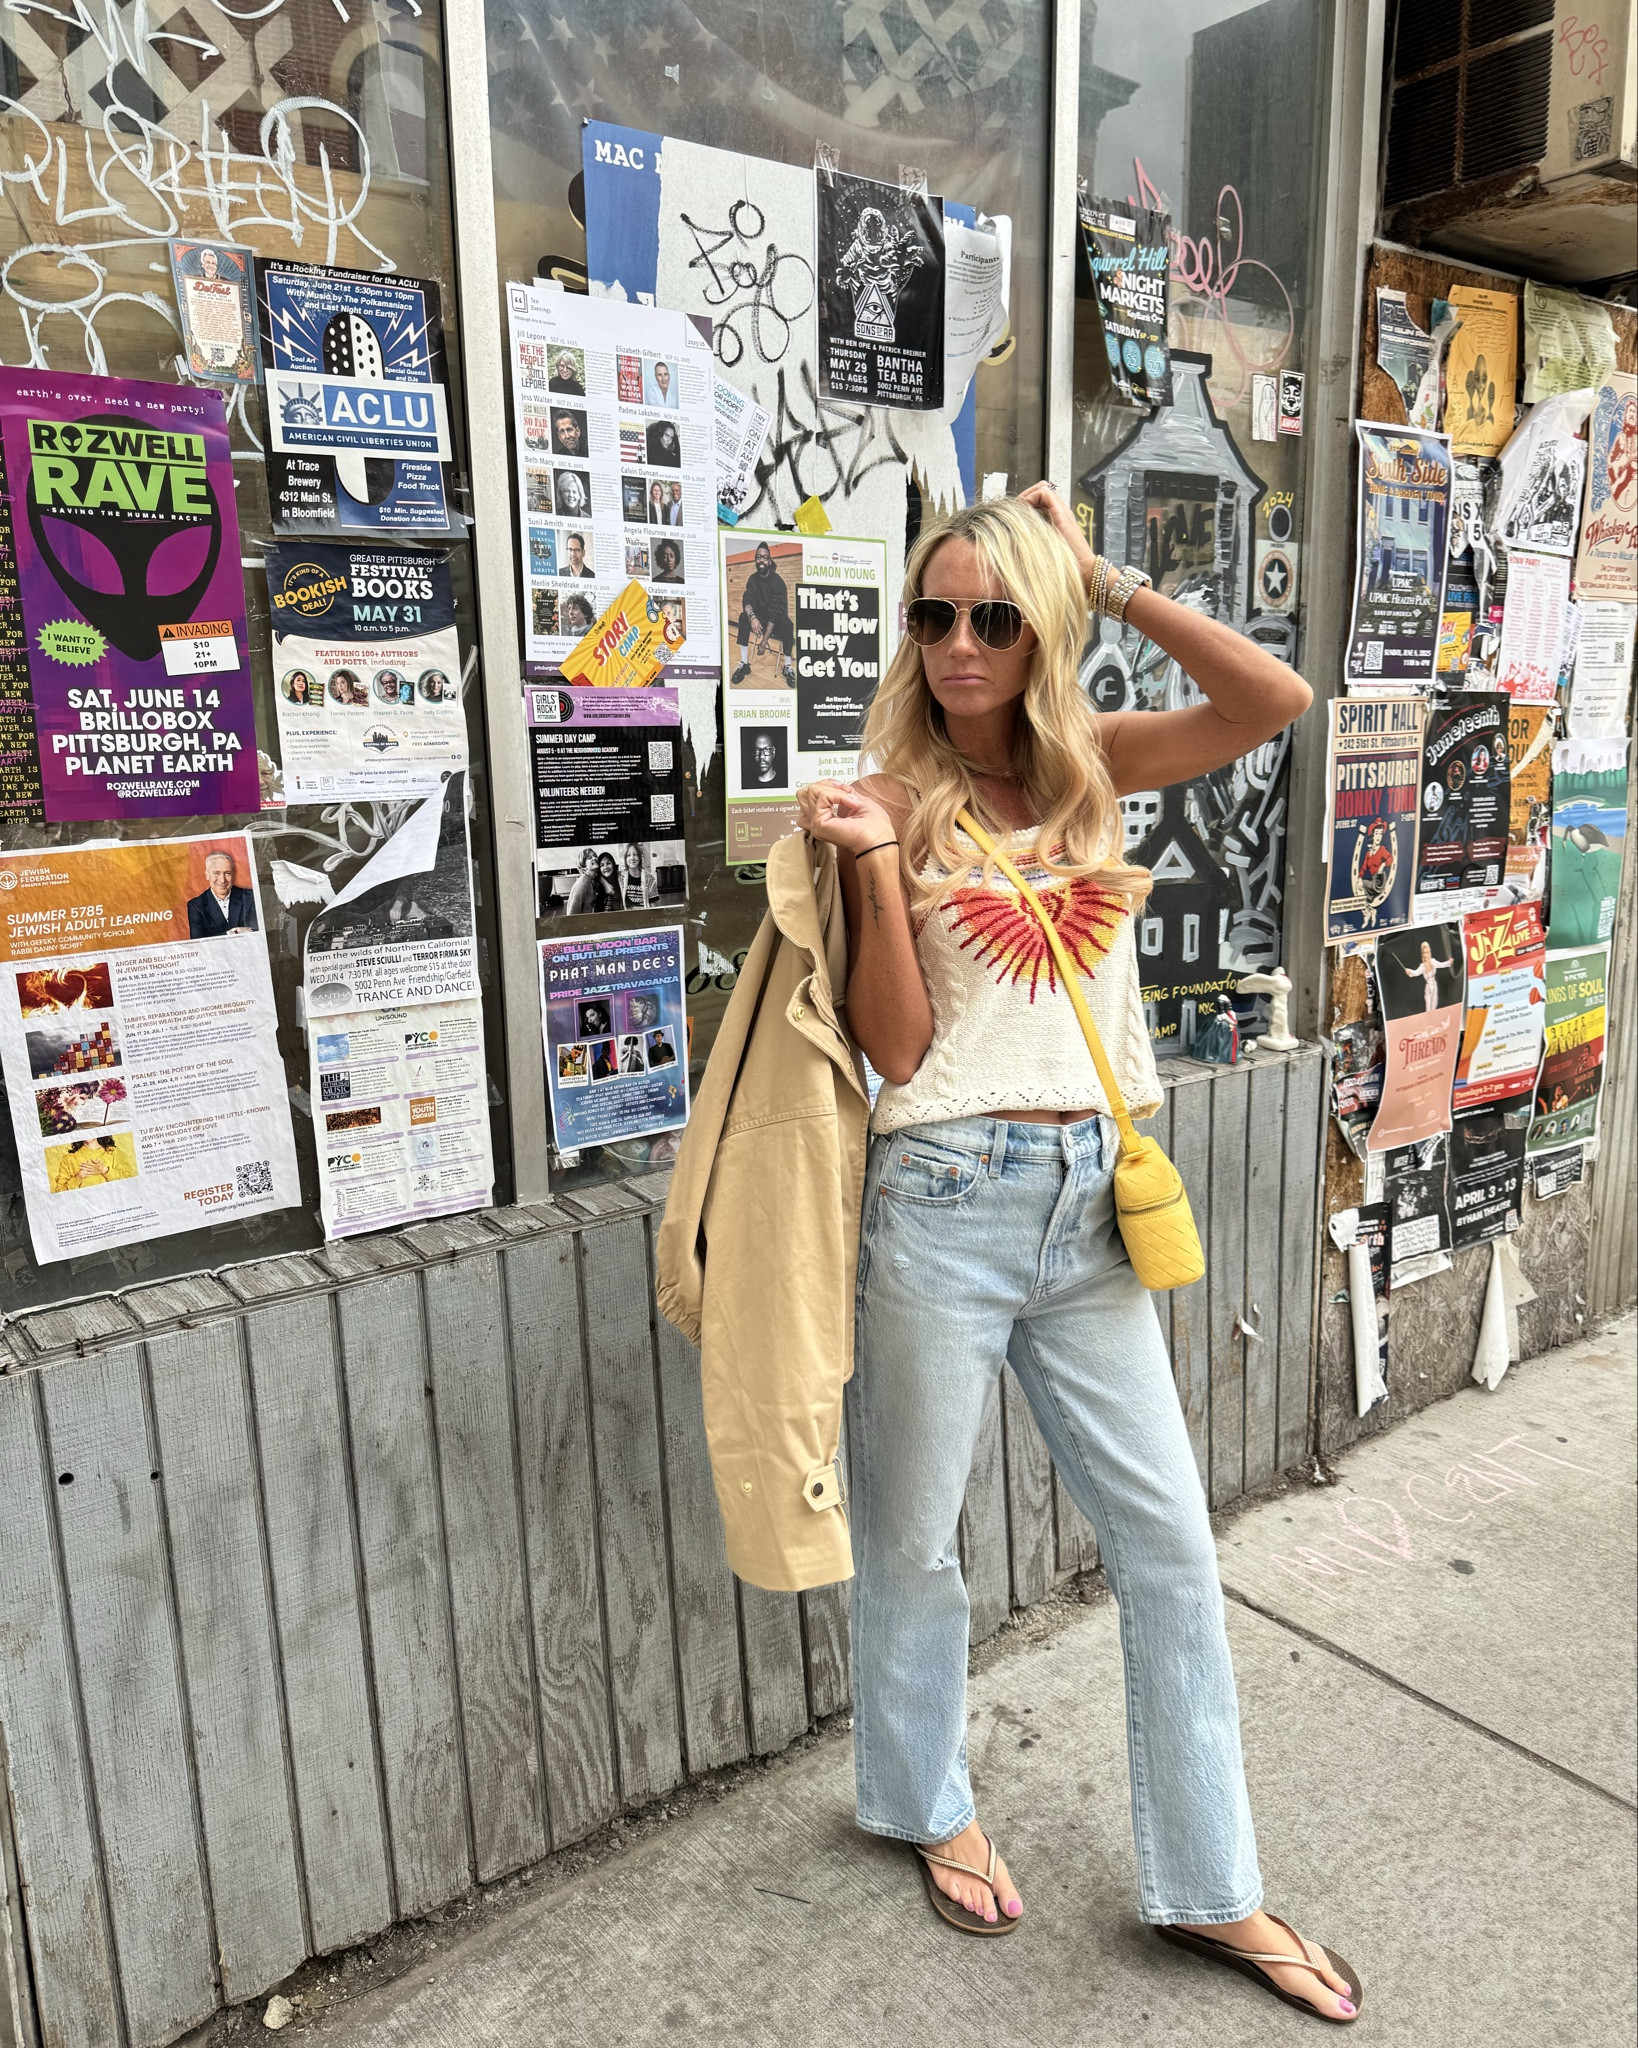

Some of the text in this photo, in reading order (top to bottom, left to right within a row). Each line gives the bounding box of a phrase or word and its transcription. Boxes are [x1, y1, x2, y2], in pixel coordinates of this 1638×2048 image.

[594, 140, 644, 170] MAC
[960, 250, 999, 264] Participants
[1138, 247, 1168, 271] Hill
[270, 262, 283, 271] It's
[293, 264, 326, 277] Rocking
[328, 268, 370, 281] Fundraiser
[372, 273, 383, 282] for
[384, 275, 397, 284] the
[398, 279, 419, 288] ACLU
[1121, 271, 1165, 296] NIGHT
[1100, 282, 1165, 315] MARKETS
[1104, 320, 1141, 339] SATURDAY
[616, 345, 661, 359] Elizabeth Gilbert
[830, 347, 867, 361] THURSDAY
[830, 358, 867, 373] MAY 29
[877, 355, 923, 373] BANTHA
[831, 371, 868, 384] ALL AGES
[878, 369, 923, 386] TEA BAR
[831, 381, 868, 394] $15 7:30PM
[16, 388, 205, 416] earth's over, need a new party!
[331, 390, 429, 428] ACLU
[619, 406, 661, 418] Padma Lakshmi
[1281, 417, 1300, 430] AWOO
[289, 432, 432, 448] AMERICAN CIVIL LIBERTIES UNION
[286, 460, 319, 472] At Trace
[402, 463, 431, 471] Fireside
[1366, 452, 1448, 486] South Side
[31, 455, 212, 515] RAVE
[288, 475, 321, 489] Brewery
[406, 473, 426, 481] Pizza
[398, 482, 440, 491] Food Truck
[279, 492, 333, 503] 4312 Main St.
[1262, 491, 1294, 518] 2024
[282, 507, 335, 518] in Bloomfield
[350, 554, 435, 566] GREATER PITTSBURGH
[351, 565, 428, 579] FESTIVAL
[806, 564, 876, 580] DAMON YOUNG
[351, 579, 433, 600] BOOKS
[531, 579, 579, 589] Merlin Sheldrake
[1392, 577, 1413, 588] UPMC
[273, 576, 347, 608] BOOKISH
[797, 587, 859, 612] That's
[302, 599, 327, 612] DEAL!
[353, 605, 422, 622] MAY 31
[176, 623, 230, 638] INVADING
[395, 625, 410, 634] p.m.
[833, 612, 878, 634] How
[47, 633, 95, 644] I WANT TO
[593, 611, 629, 666] STORY
[619, 625, 640, 657] CAMP
[797, 630, 849, 656] They
[56, 644, 91, 655] BELIEVE
[194, 660, 217, 668] 10PM
[799, 656, 878, 678] Get You
[68, 688, 220, 709] SAT, JUNE 14
[80, 711, 214, 731] BRILLOBOX
[733, 709, 791, 719] BRIAN BROOME
[1340, 702, 1418, 733] SPIRIT HALL
[52, 732, 242, 754] PITTSBURGH, PA
[535, 733, 596, 744] SUMMER DAY CAMP
[1343, 737, 1379, 749] 242 51st St.
[66, 754, 233, 776] PLANET EARTH
[1337, 759, 1417, 790] PITTSBURGH
[106, 780, 200, 791] ROZWELLRAVE.COM
[117, 788, 191, 798] @ROZWELLRAVE
[539, 786, 605, 797] VOLUNTEERS NEEDED!
[1335, 786, 1415, 819] HONKY TONK
[19, 868, 50, 877] JEWISH
[20, 873, 69, 884] FEDERATION
[7, 904, 104, 926] SUMMER 5785
[8, 910, 173, 939] JEWISH ADULT LEARNING
[563, 936, 658, 954] BLUE MOON BAR
[1513, 929, 1531, 946] LIVE
[550, 955, 675, 982] PHAT MAN DEE'S
[354, 976, 405, 991] 5002 Penn Ave
[1567, 979, 1604, 1000] OF SOUL
[356, 981, 476, 1004] TRANCE AND DANCE!
[1399, 1034, 1448, 1070] THREADS
[183, 1183, 233, 1201] REGISTER
[198, 1192, 234, 1207] TODAY
[1455, 1177, 1517, 1210] APRIL 3 13
[1456, 1200, 1511, 1227] BYHAM THEATER
